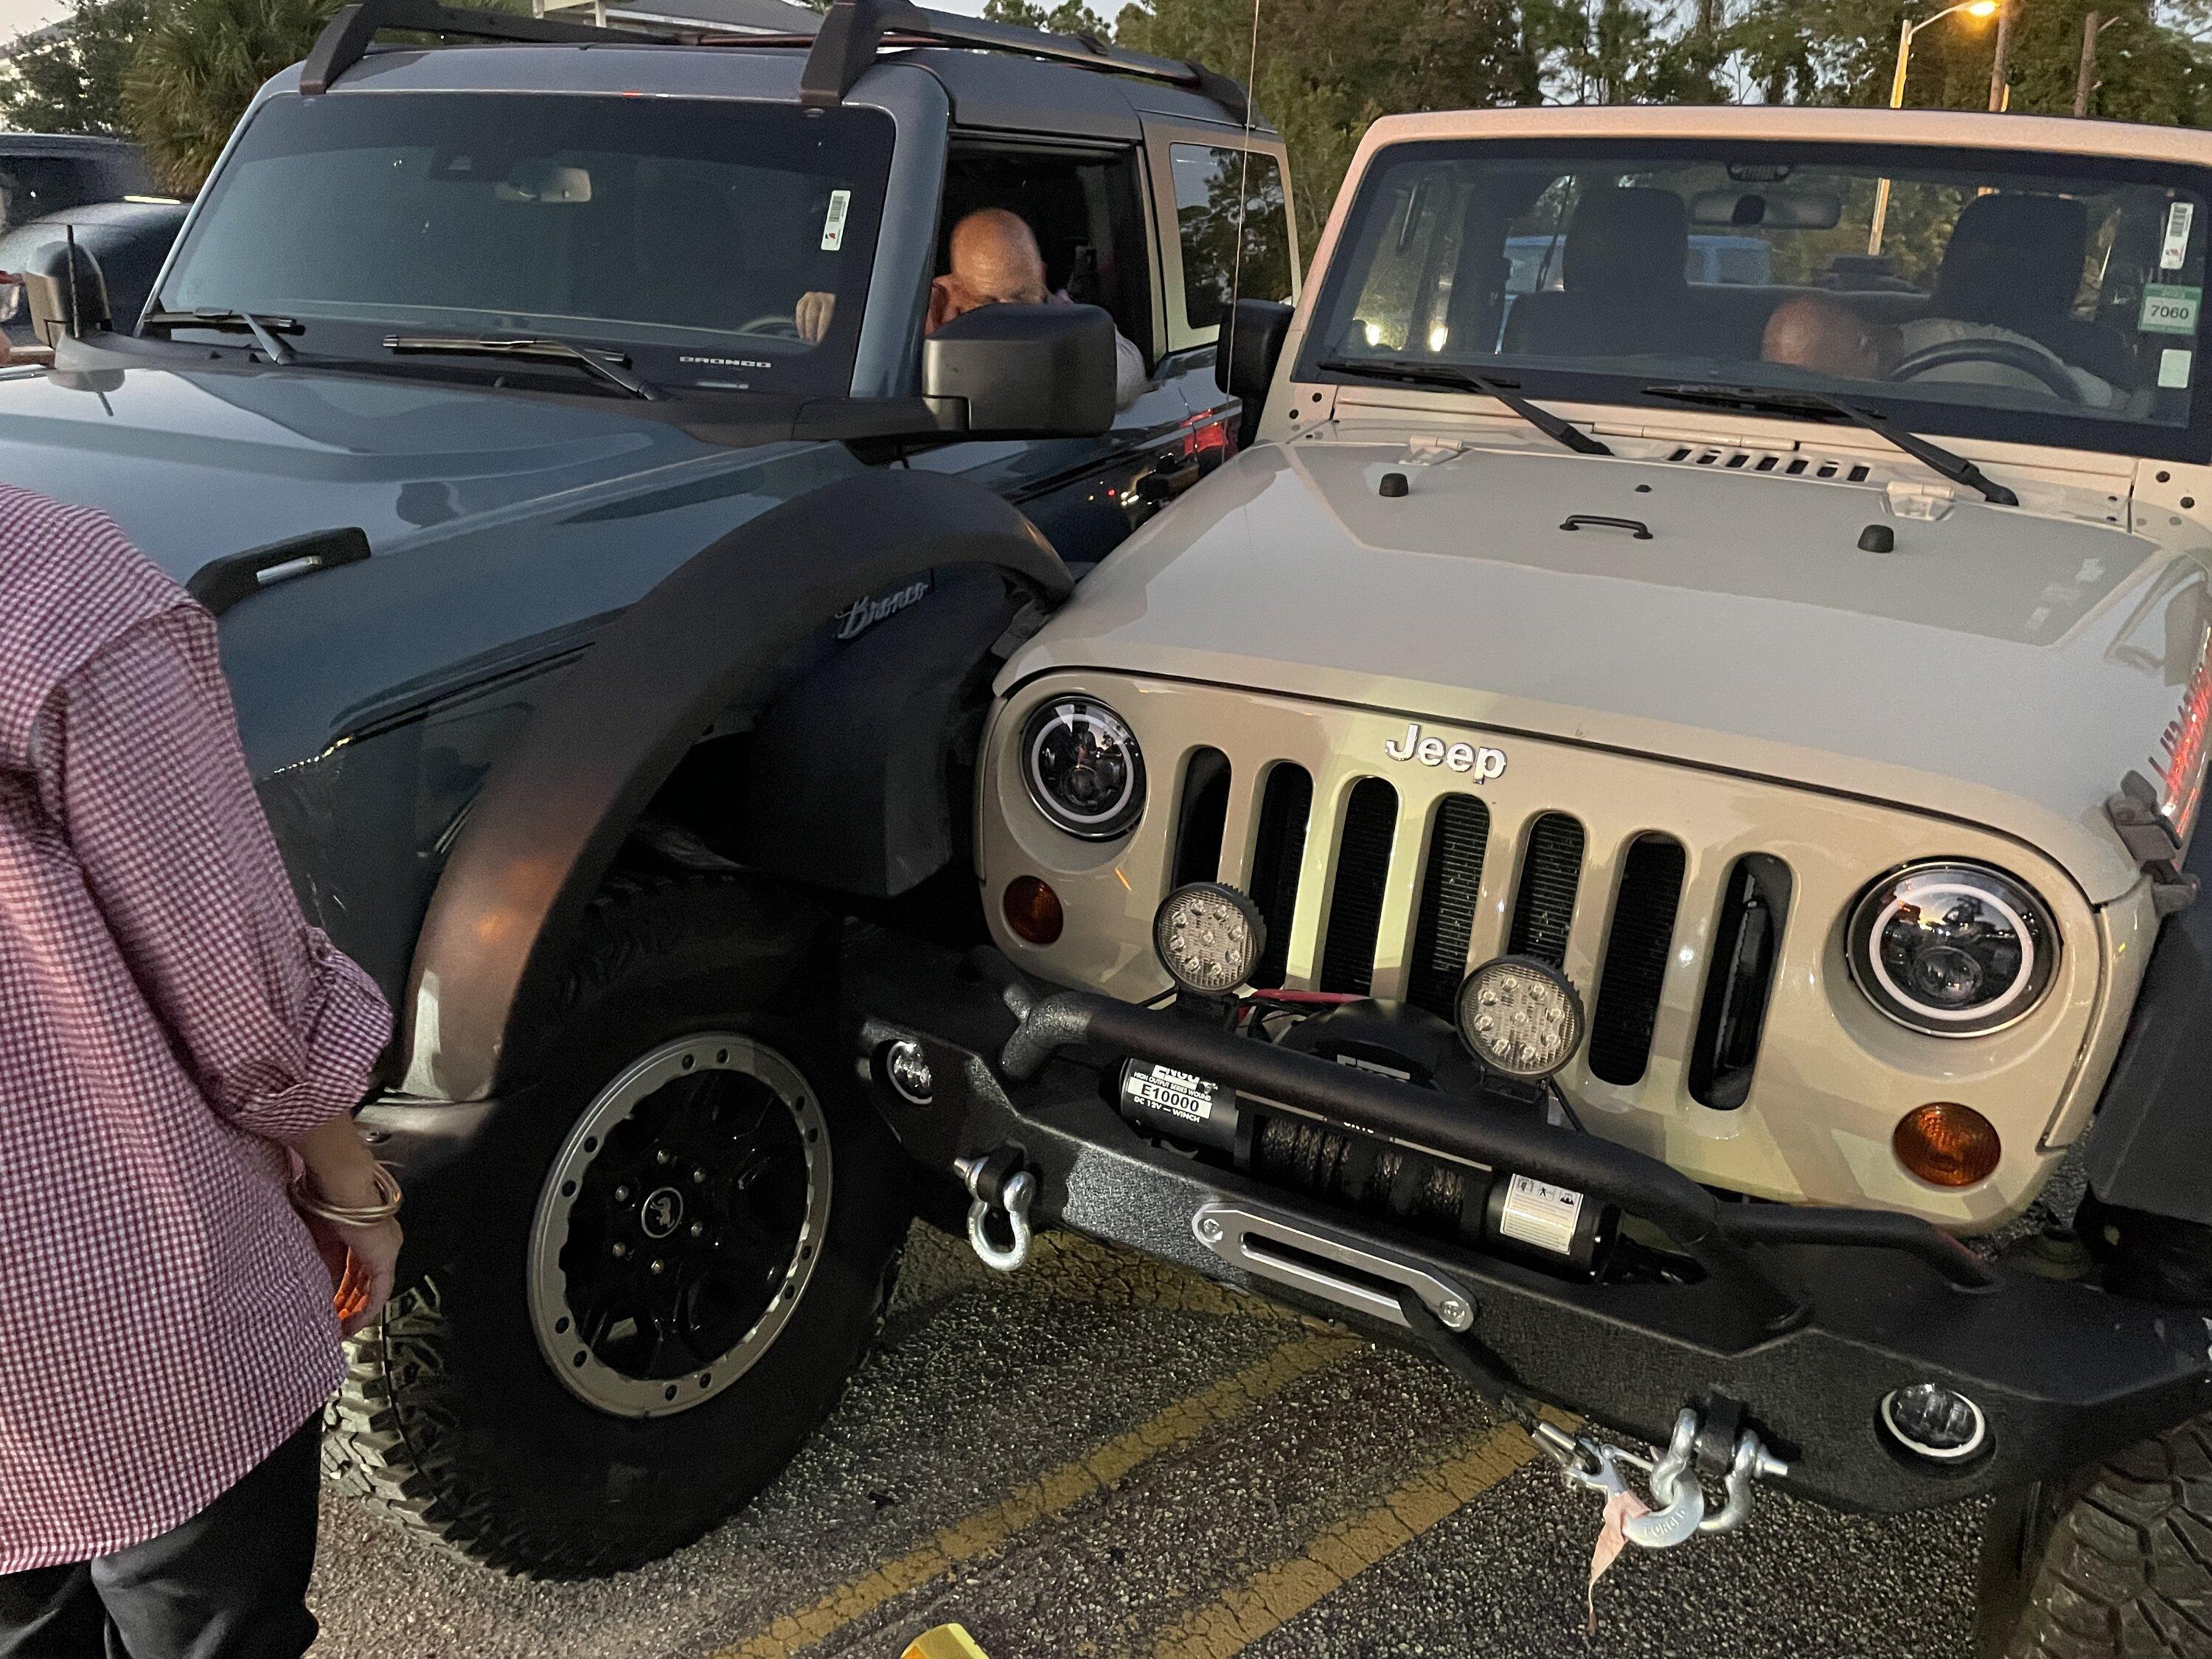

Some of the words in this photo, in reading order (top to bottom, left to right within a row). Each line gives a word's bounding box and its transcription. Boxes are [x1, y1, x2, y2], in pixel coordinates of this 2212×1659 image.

[2151, 304, 2189, 320] 7060
[679, 356, 771, 368] BRONCO
[835, 582, 929, 639] Bronco
[1385, 723, 1508, 785] Jeep
[1133, 1071, 1149, 1081] HIGH
[1148, 1076, 1170, 1088] OUTPUT
[1169, 1082, 1188, 1093] SERIES
[1188, 1088, 1211, 1101] WOUND
[1141, 1083, 1200, 1112] E10000
[1133, 1095, 1145, 1105] DC
[1147, 1099, 1163, 1110] 12V
[1172, 1108, 1200, 1123] WINCH
